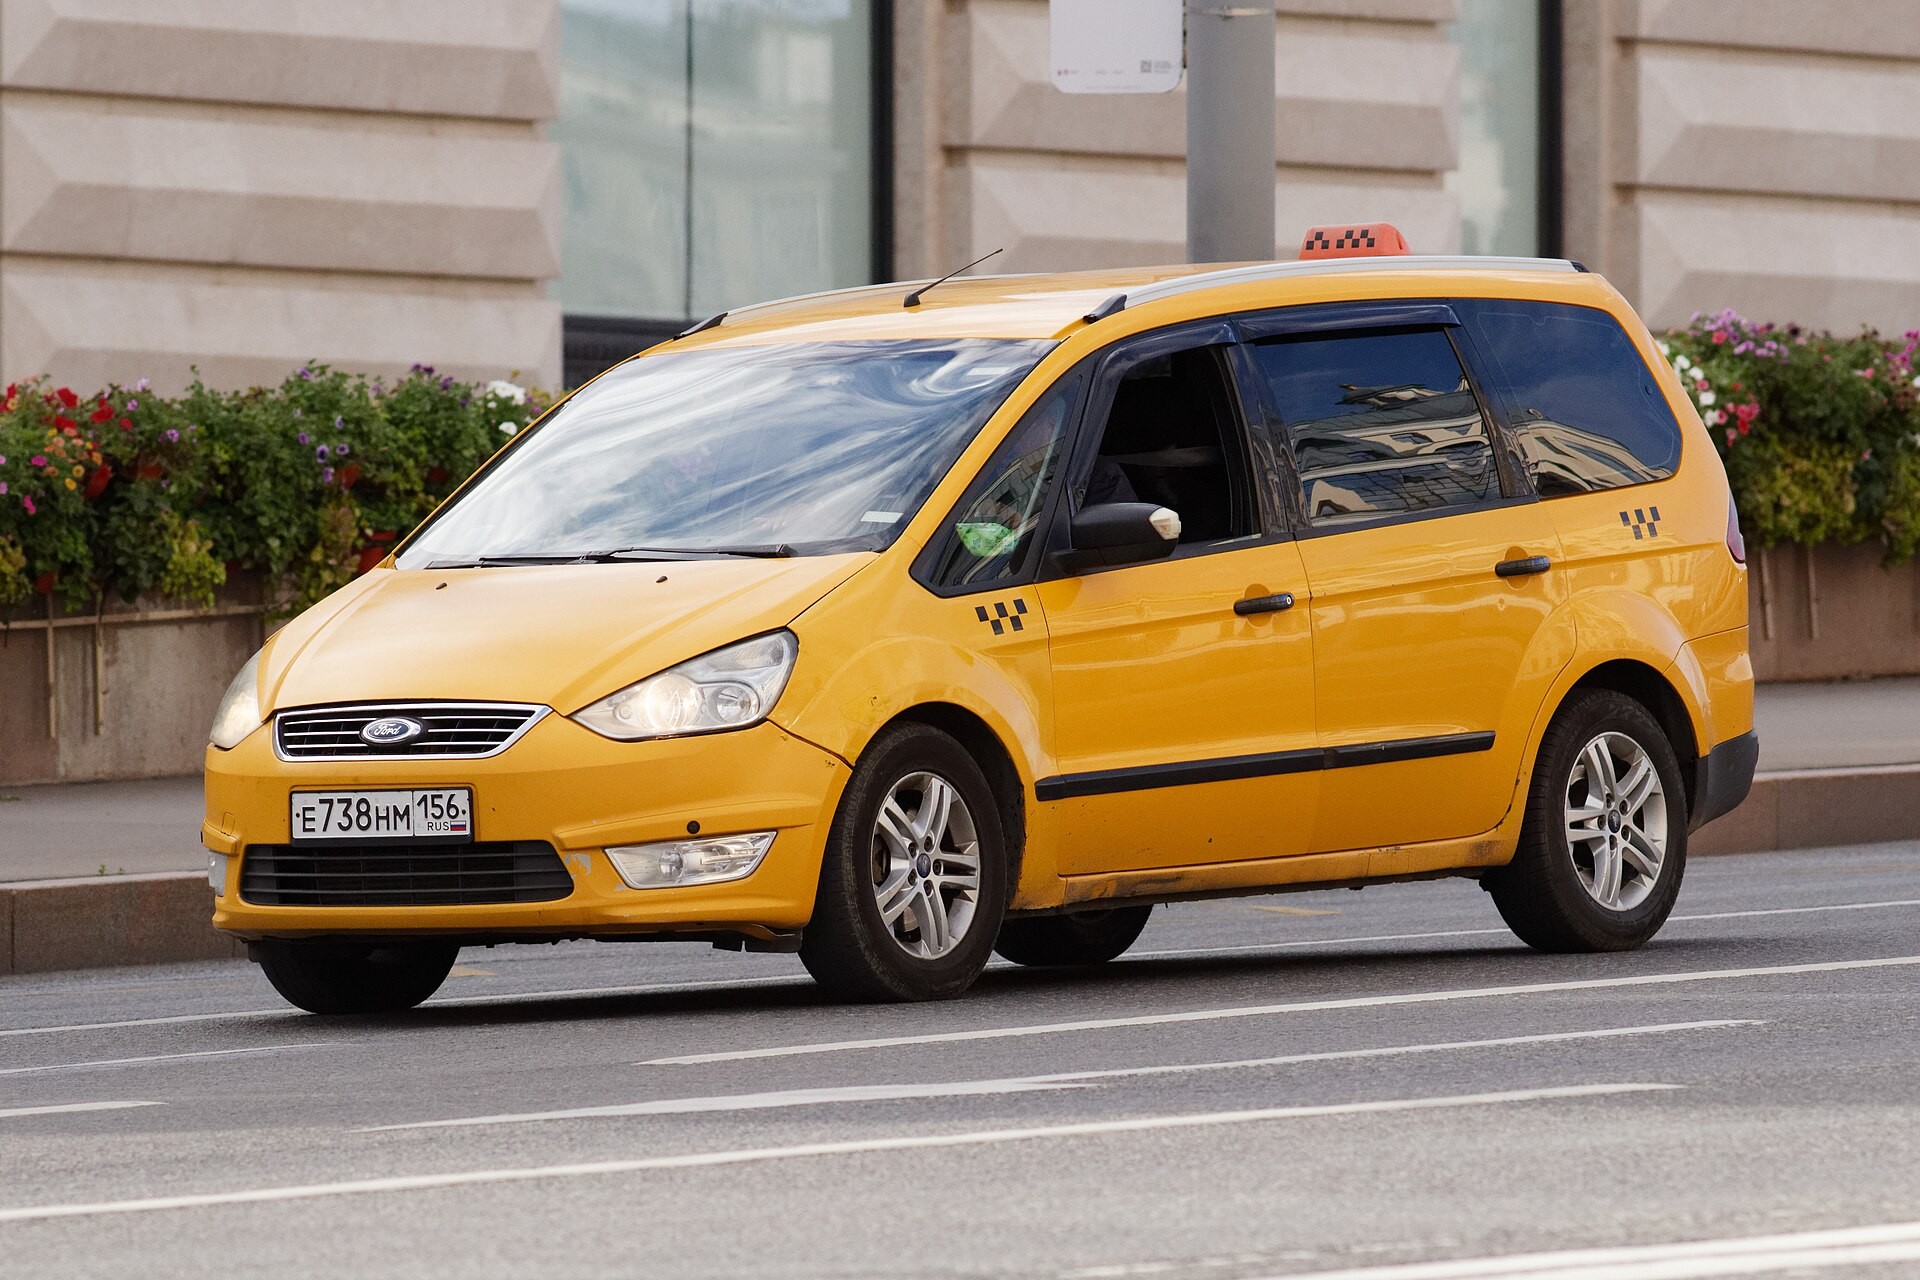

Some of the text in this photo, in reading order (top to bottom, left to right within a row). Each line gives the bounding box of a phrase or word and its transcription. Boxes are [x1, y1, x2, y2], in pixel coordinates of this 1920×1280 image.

[374, 723, 402, 736] Ford
[417, 794, 459, 819] 156
[427, 822, 449, 831] RUS
